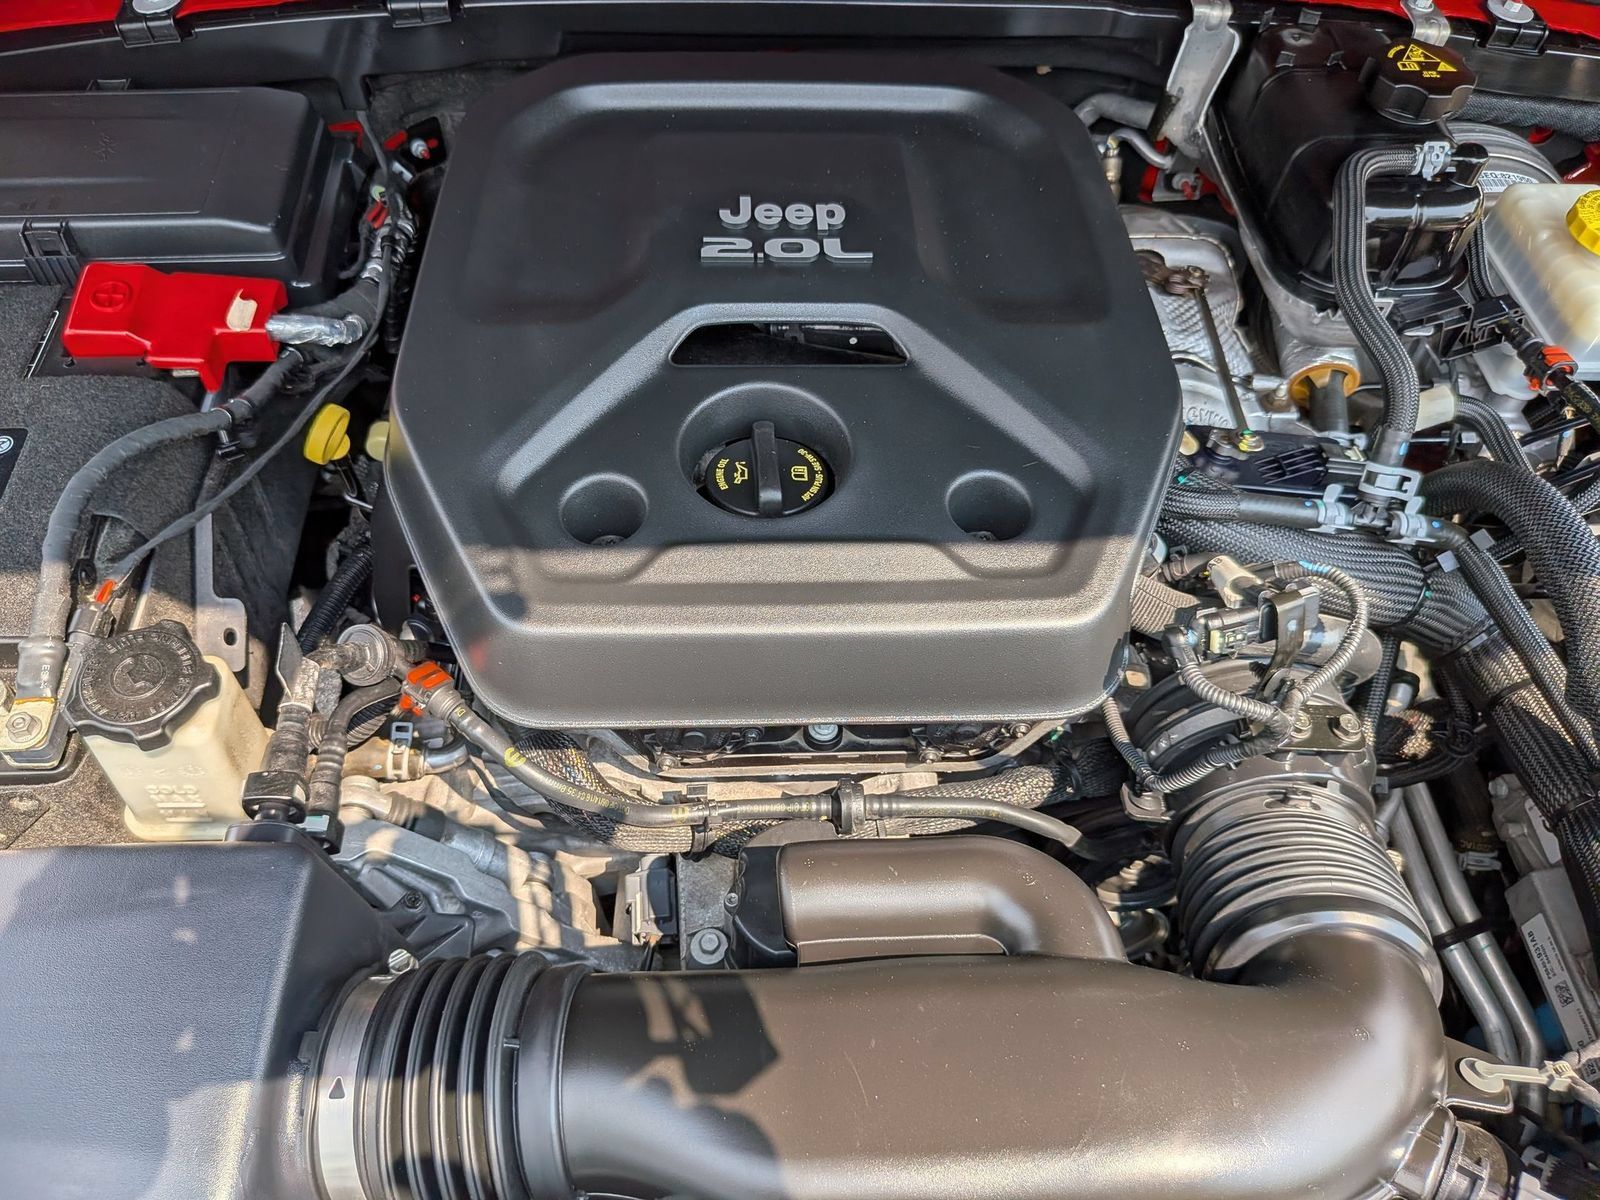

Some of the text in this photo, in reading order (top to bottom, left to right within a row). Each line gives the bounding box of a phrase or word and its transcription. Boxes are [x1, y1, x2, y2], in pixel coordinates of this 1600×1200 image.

[719, 195, 846, 231] Jeep
[700, 237, 874, 259] 2.0L
[716, 458, 729, 490] ENGINE OIL
[145, 784, 199, 795] COLD
